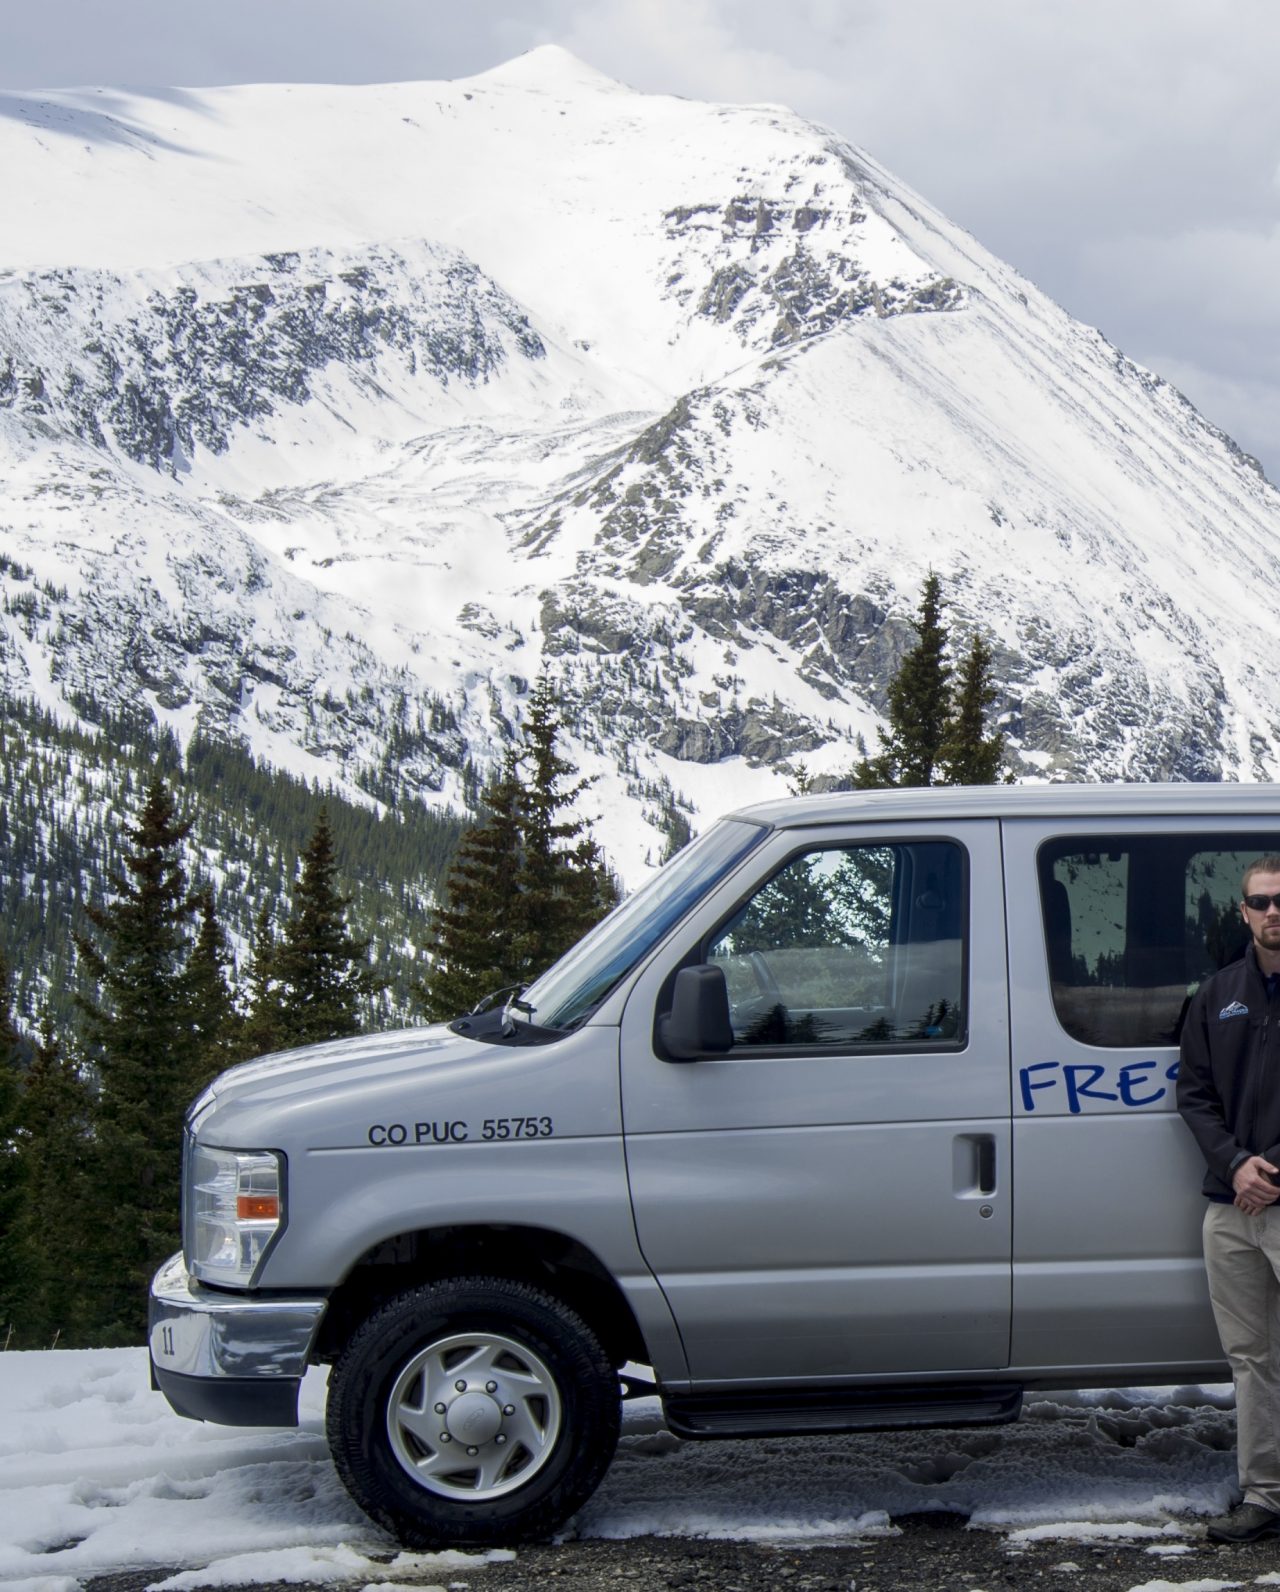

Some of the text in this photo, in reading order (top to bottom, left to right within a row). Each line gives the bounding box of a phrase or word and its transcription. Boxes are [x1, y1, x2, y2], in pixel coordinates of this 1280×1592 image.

[1019, 1061, 1181, 1114] FRE
[368, 1116, 553, 1146] CO PUC 55753
[162, 1326, 175, 1356] 11
